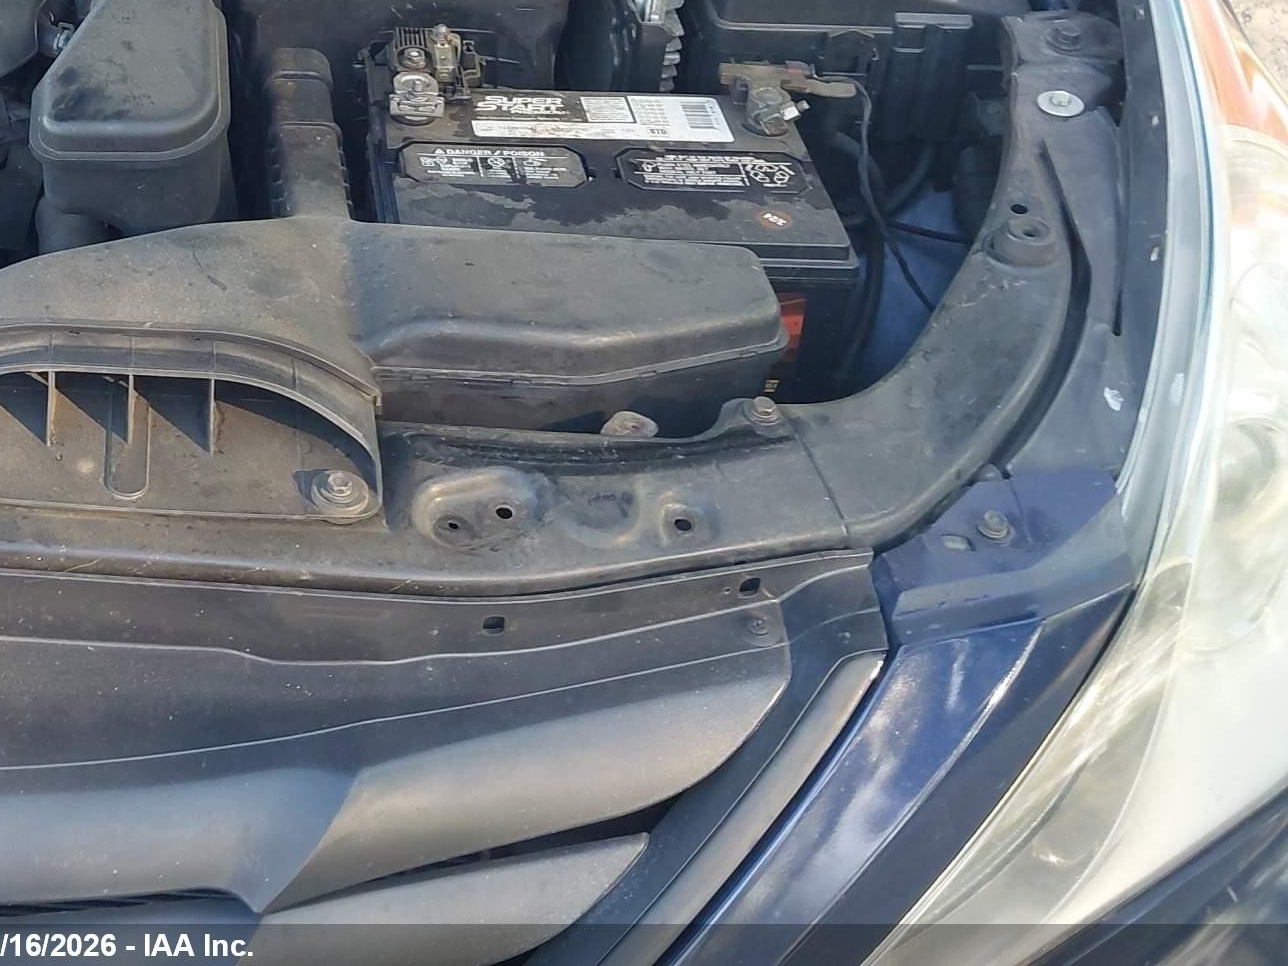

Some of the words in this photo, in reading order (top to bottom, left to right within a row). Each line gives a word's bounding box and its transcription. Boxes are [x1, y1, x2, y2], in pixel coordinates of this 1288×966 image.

[485, 95, 563, 108] SUPER
[473, 102, 565, 114] START
[446, 148, 492, 156] DANGER
